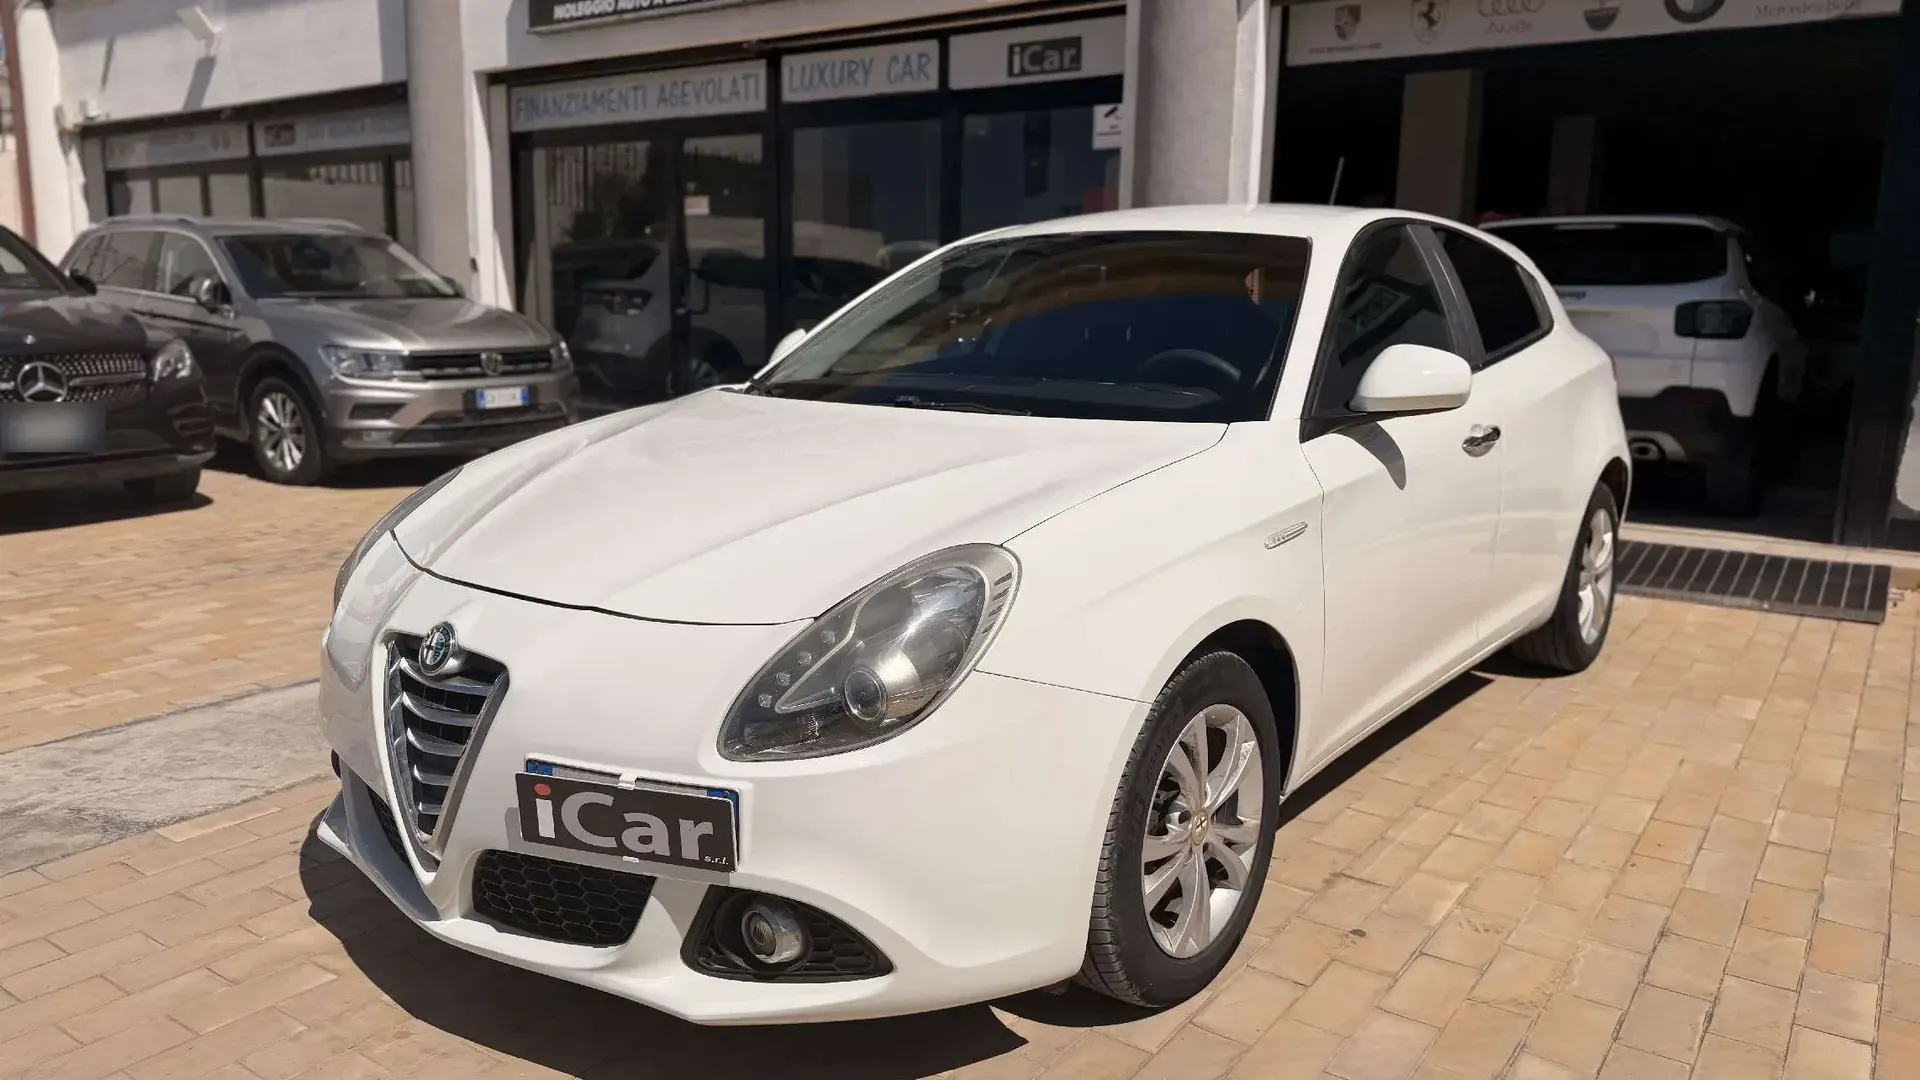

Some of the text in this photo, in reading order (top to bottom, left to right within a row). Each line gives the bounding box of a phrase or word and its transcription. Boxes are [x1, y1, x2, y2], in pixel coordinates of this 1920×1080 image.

[553, 0, 614, 20] NOLEGGIO
[788, 52, 931, 92] LUXURY CAR
[1012, 43, 1078, 75] iCar
[516, 73, 760, 122] FINANZIAMENTI AGEVOLATI
[534, 783, 714, 861] iCar
[703, 853, 729, 866] s.r.l.
